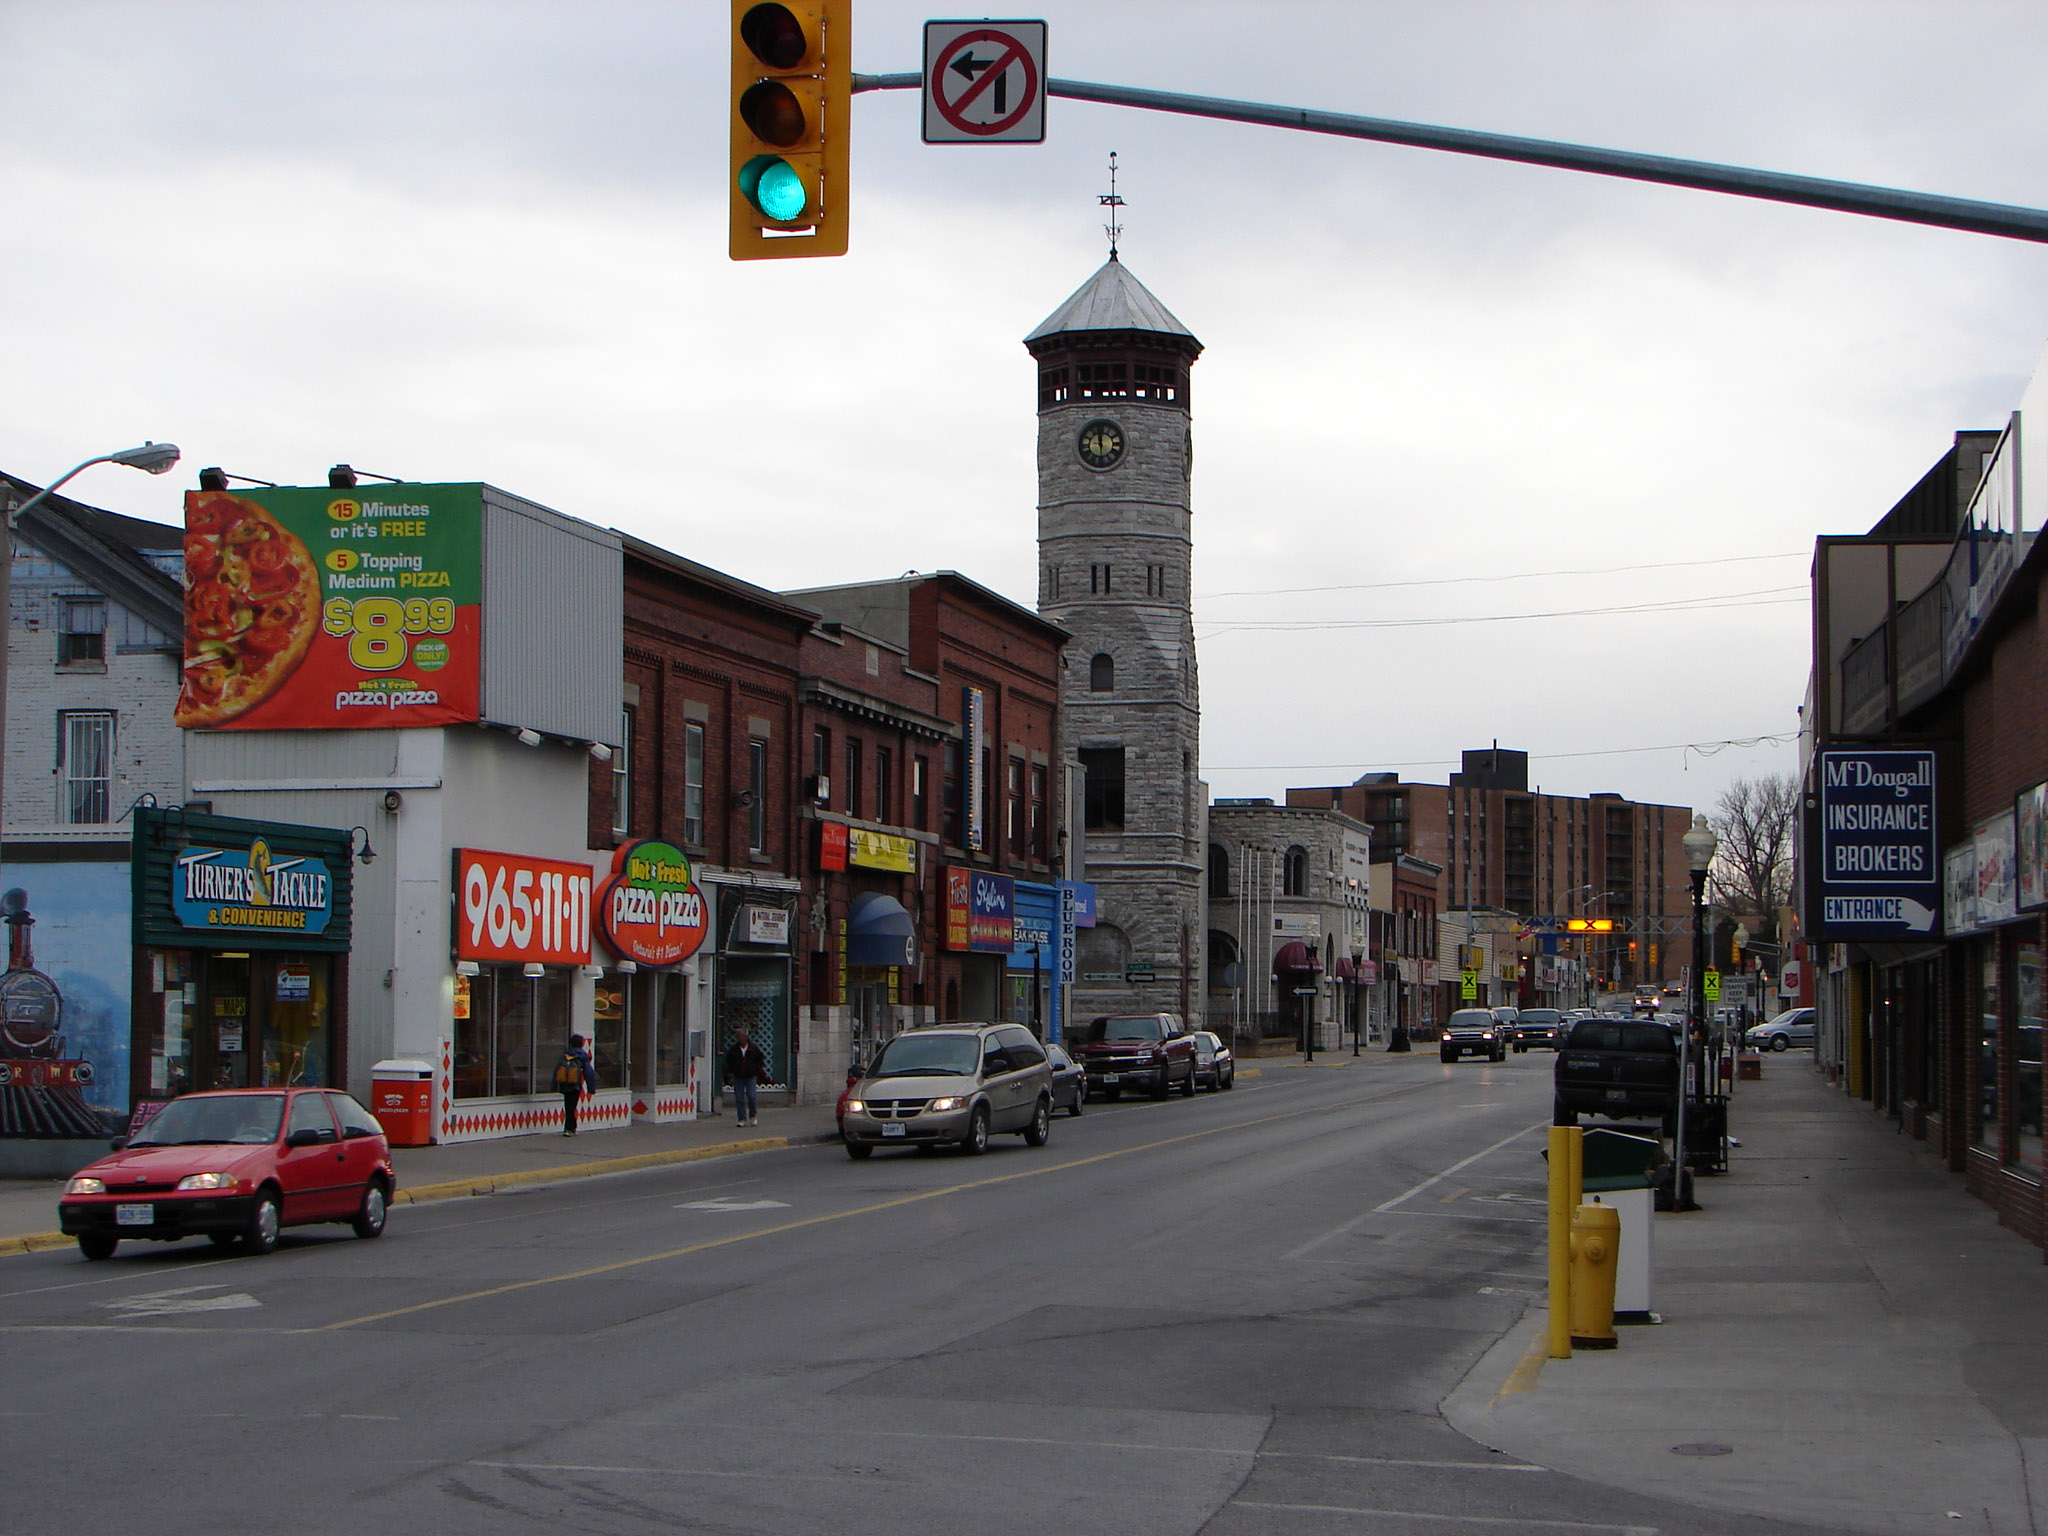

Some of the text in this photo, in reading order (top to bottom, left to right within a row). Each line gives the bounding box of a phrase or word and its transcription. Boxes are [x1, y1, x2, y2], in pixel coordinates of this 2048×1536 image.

[334, 502, 430, 518] 15 Minutes
[330, 521, 426, 538] or it's FREE
[337, 553, 422, 572] 5 Topping
[328, 572, 450, 589] Medium PIZZA
[358, 681, 379, 690] Hot
[336, 690, 439, 710] pizza pizza
[1826, 760, 1931, 797] McDougall
[1829, 804, 1929, 830] INSURANCE
[1835, 845, 1924, 871] BROKERS
[631, 858, 651, 881] Hot
[656, 859, 688, 885] Fresh
[208, 907, 306, 928] & CONVENIENCE
[613, 886, 700, 938] pizza pizza
[1826, 898, 1903, 920] ENTRANCE
[1028, 930, 1048, 944] HOUSE
[1062, 889, 1073, 982] BLUE ROOM
